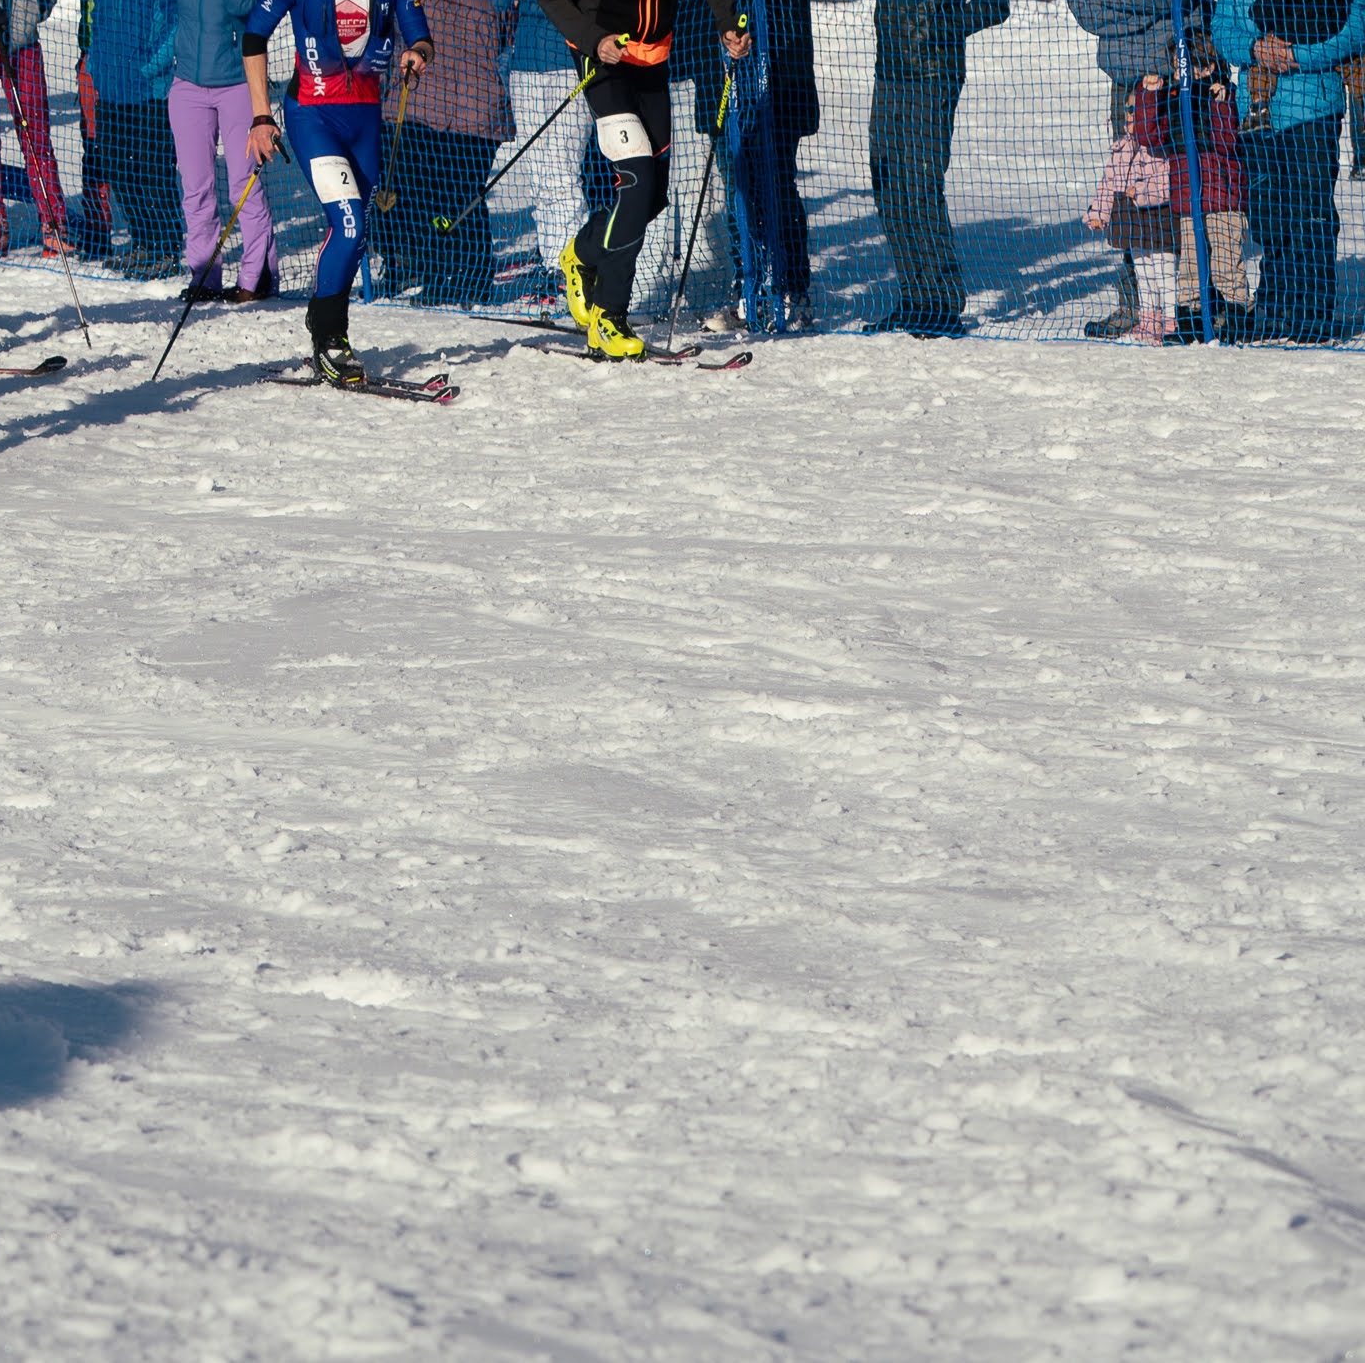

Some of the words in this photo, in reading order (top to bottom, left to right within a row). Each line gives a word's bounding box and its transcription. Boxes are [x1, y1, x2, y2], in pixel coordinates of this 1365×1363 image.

[1179, 38, 1188, 87] LISKI
[619, 130, 629, 144] 3
[341, 171, 350, 185] 2
